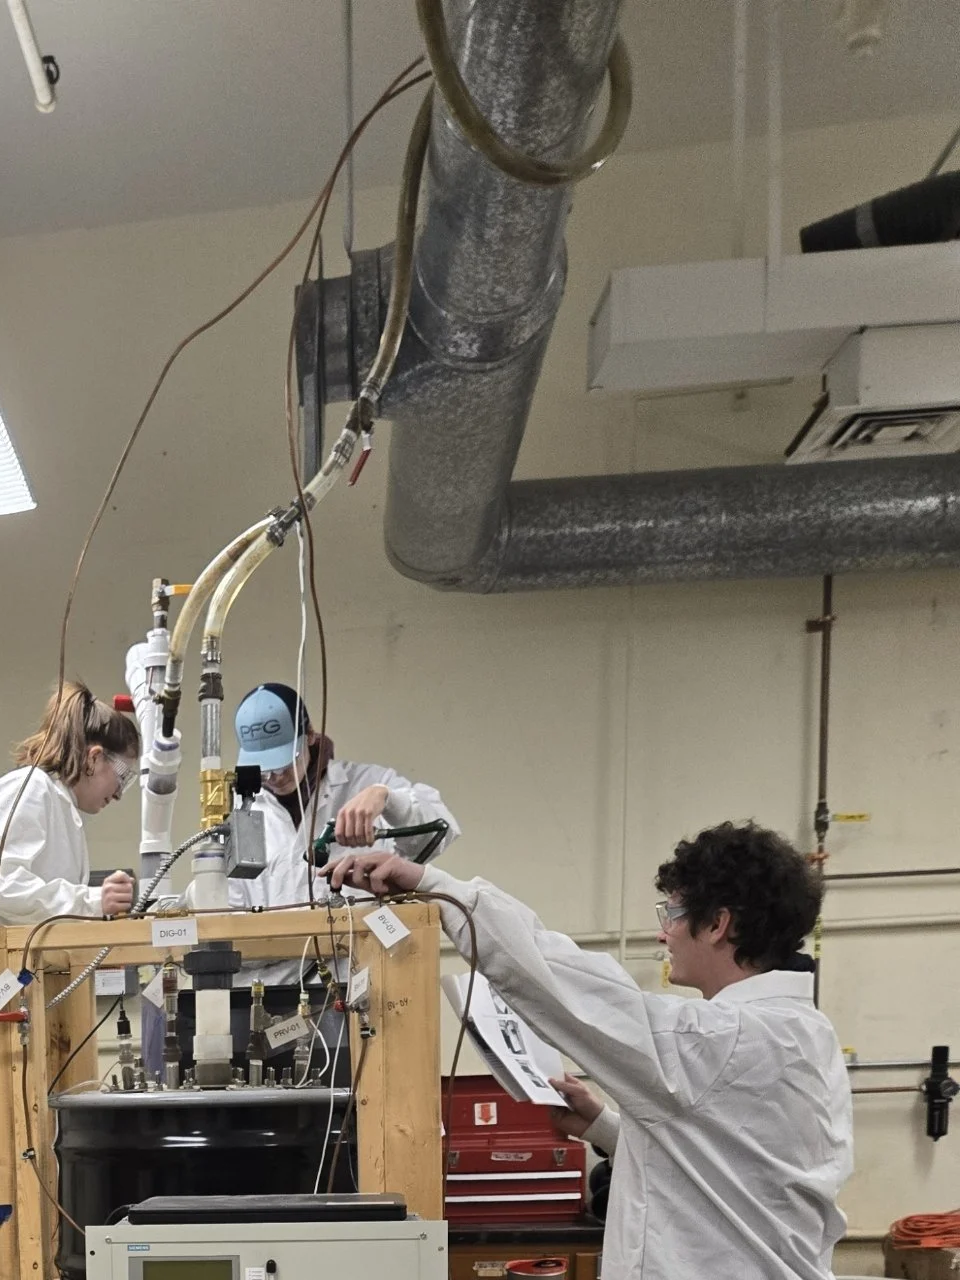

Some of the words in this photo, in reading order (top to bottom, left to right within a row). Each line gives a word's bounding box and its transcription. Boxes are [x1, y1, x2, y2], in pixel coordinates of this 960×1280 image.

[240, 720, 281, 739] PFG
[327, 915, 354, 925] BV-0
[378, 914, 397, 935] BV-03
[159, 928, 187, 938] DIG-01
[273, 1022, 300, 1040] PRV-01
